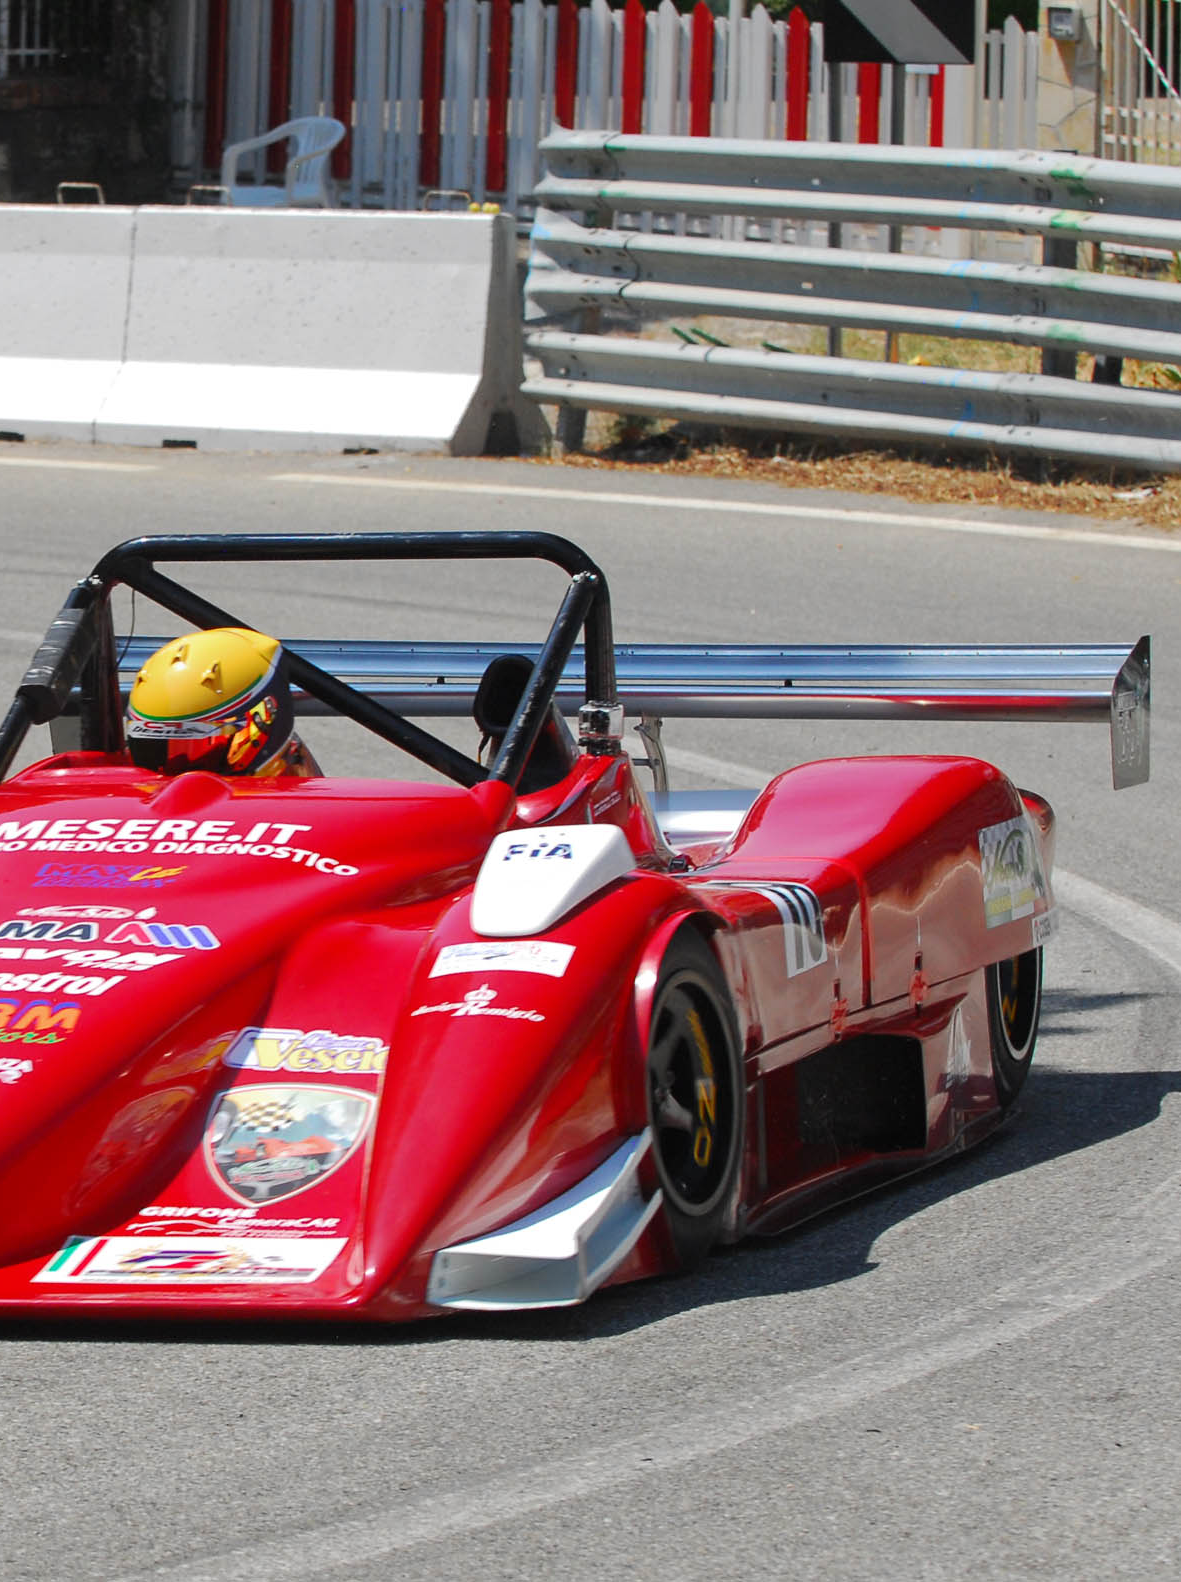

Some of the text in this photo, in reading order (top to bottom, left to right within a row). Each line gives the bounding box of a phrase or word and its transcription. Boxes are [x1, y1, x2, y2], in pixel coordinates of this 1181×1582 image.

[29, 840, 149, 853] MEDICO
[152, 841, 359, 876] DIAGNOSTICO
[138, 1206, 259, 1218] GRIFONE
